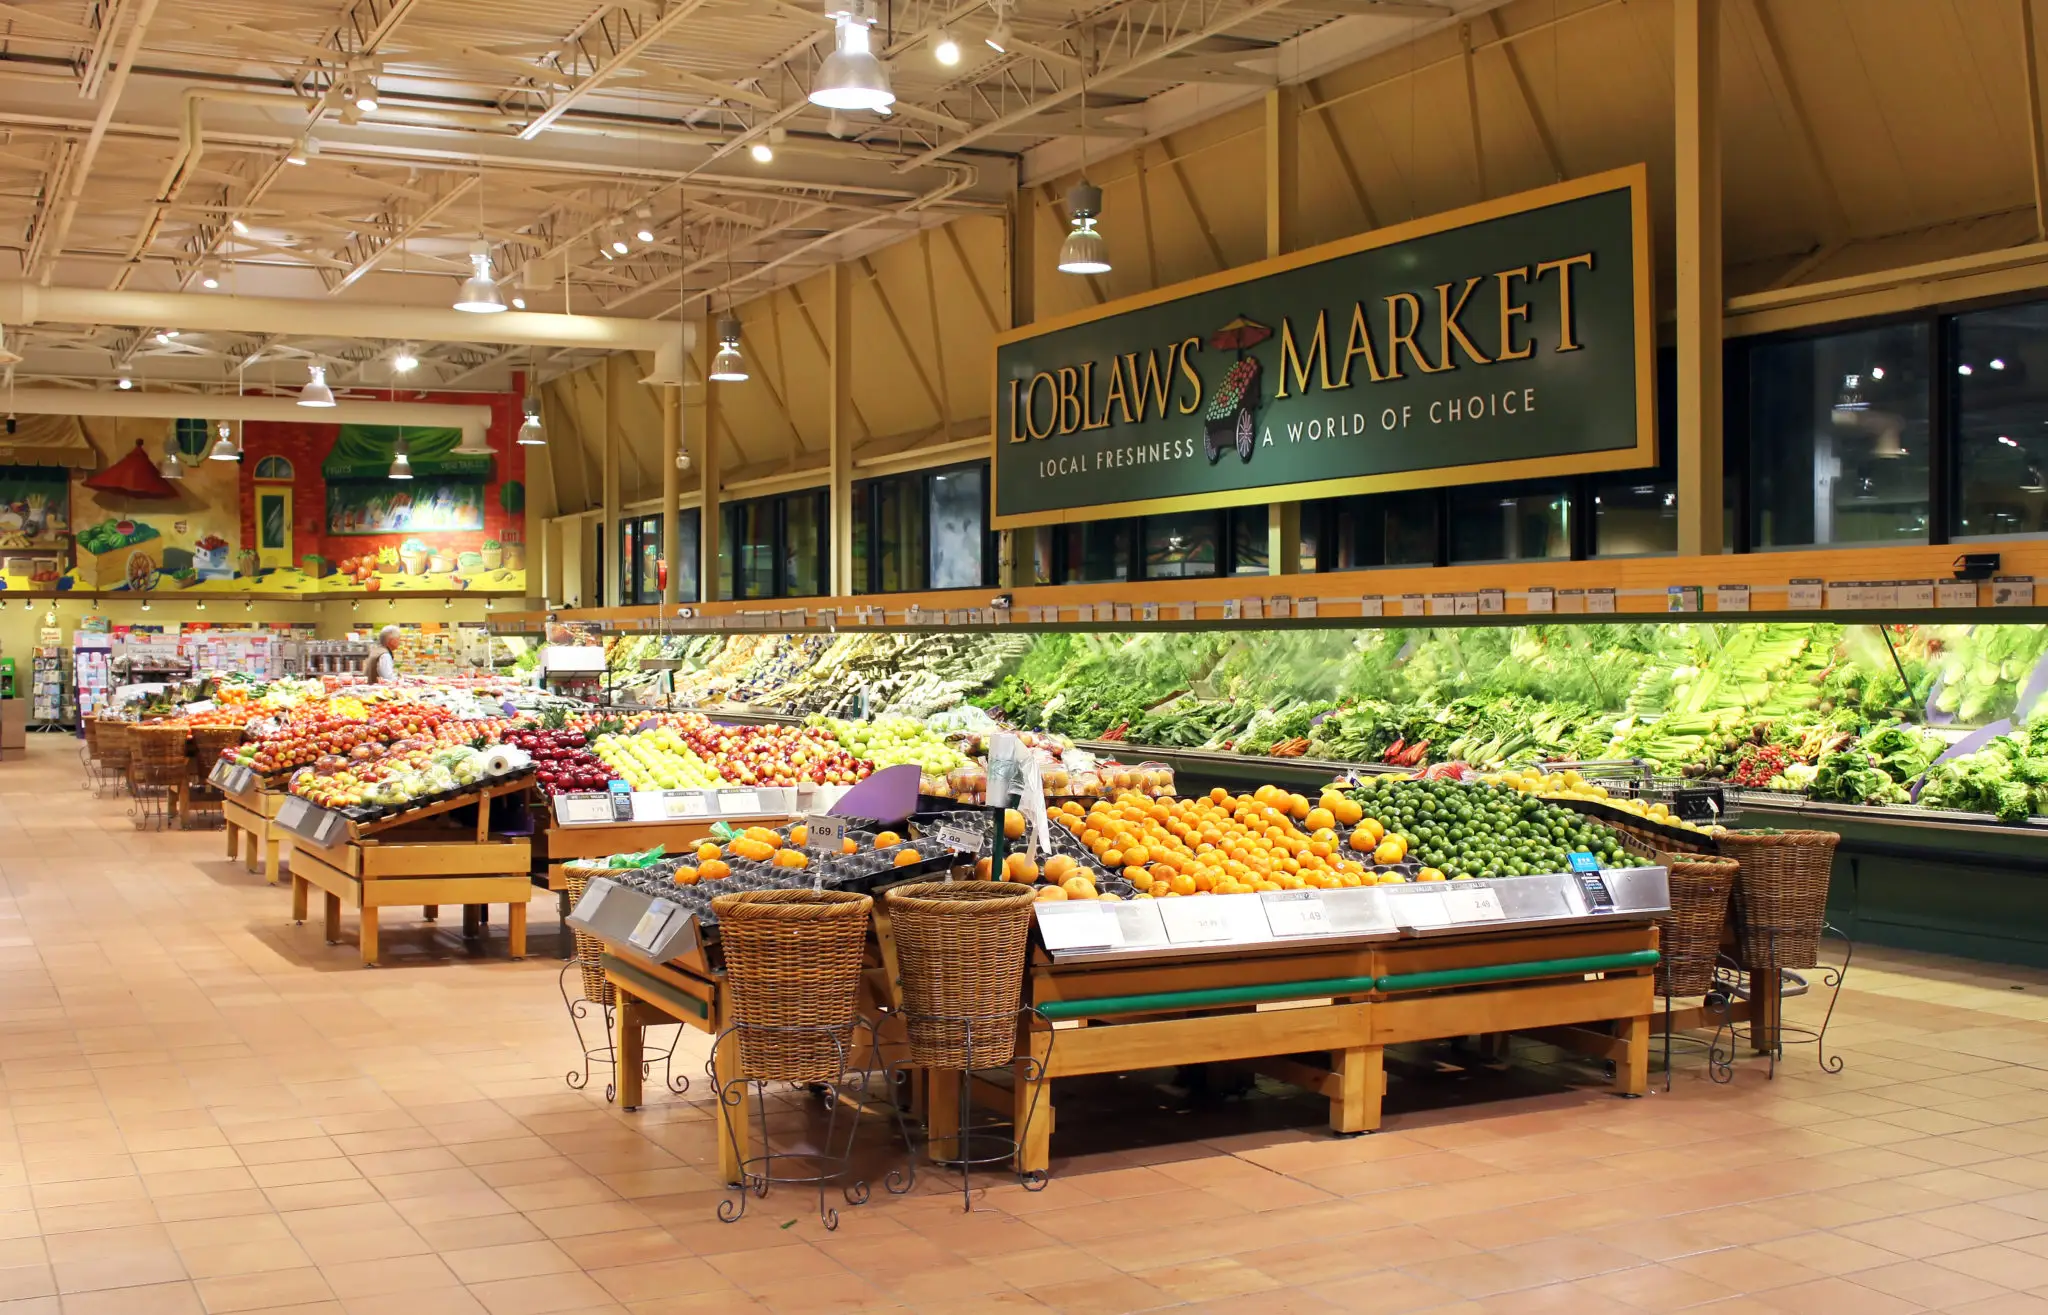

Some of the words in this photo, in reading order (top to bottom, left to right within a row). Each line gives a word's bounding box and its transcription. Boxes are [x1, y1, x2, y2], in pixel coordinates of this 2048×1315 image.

[1008, 336, 1204, 445] LOBLAWS
[1275, 251, 1595, 400] MARKET
[1262, 426, 1275, 448] A
[1287, 412, 1366, 443] WORLD
[1381, 406, 1413, 430] OF
[1428, 387, 1536, 425] CHOICE
[1039, 451, 1088, 479] LOCAL
[1096, 437, 1195, 471] FRESHNESS
[1300, 911, 1322, 921] 1.49
